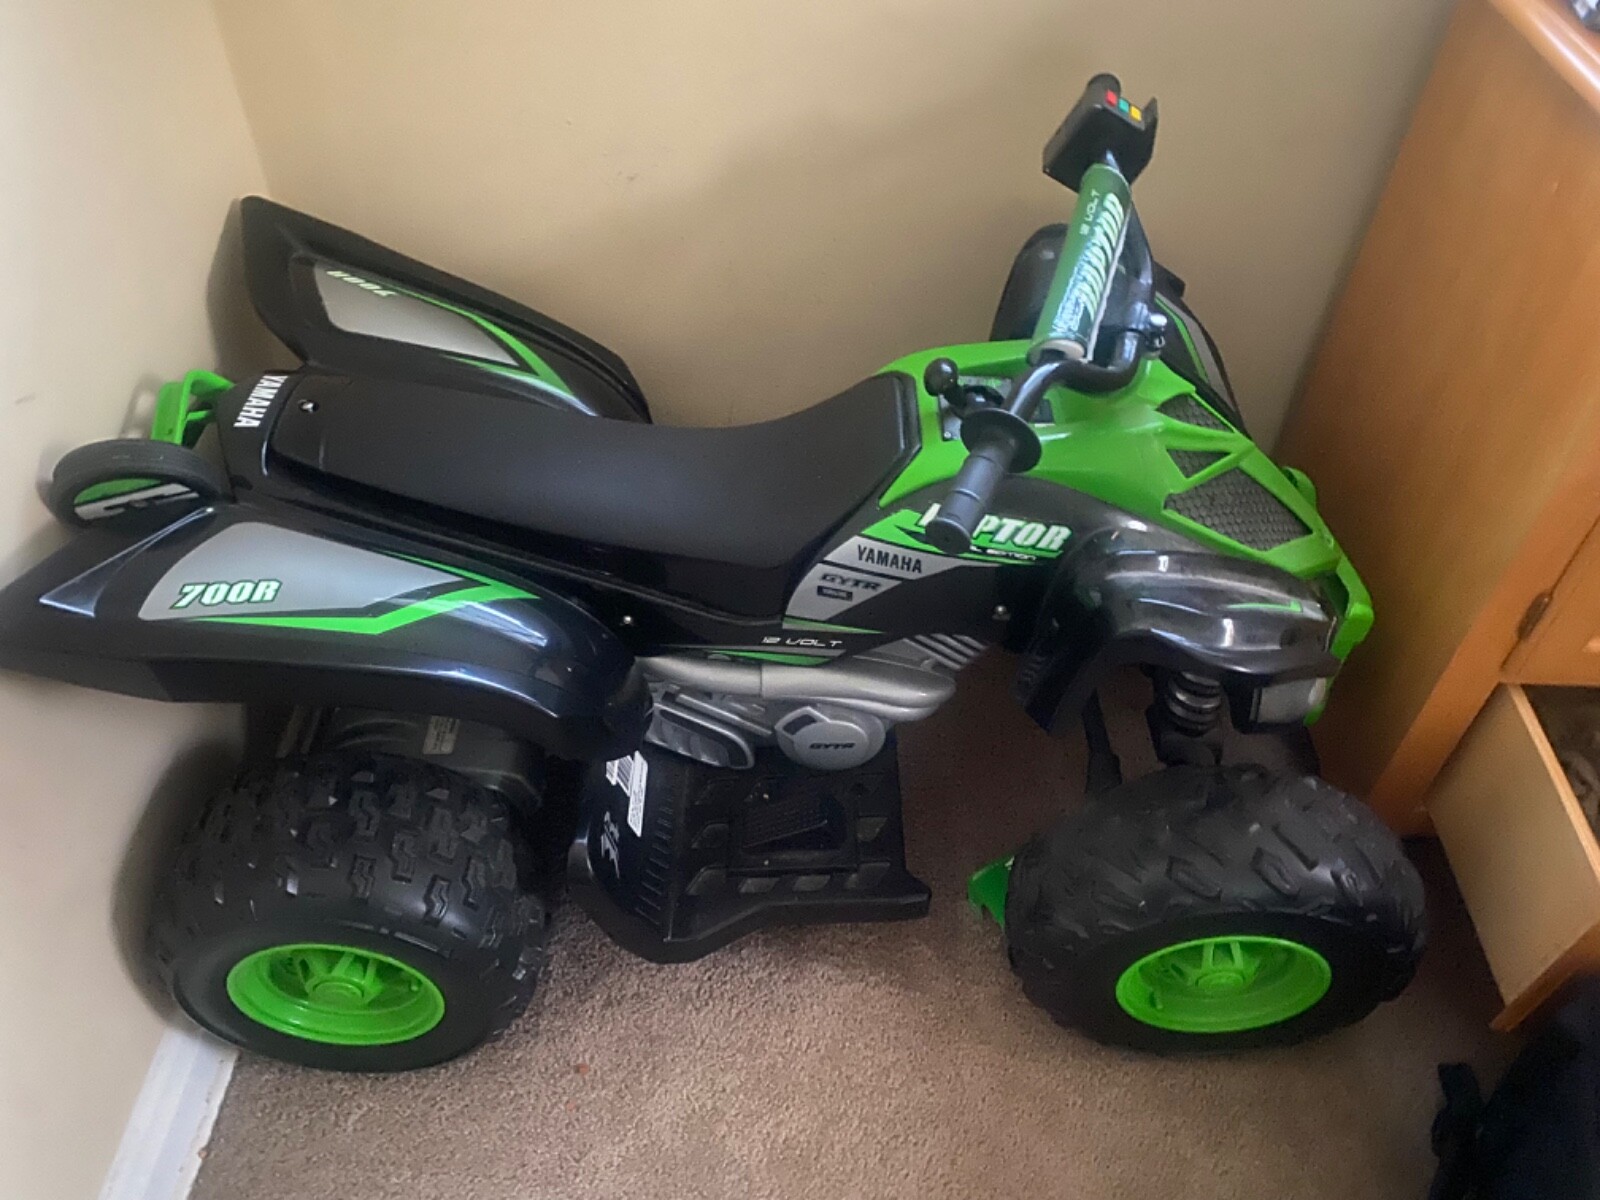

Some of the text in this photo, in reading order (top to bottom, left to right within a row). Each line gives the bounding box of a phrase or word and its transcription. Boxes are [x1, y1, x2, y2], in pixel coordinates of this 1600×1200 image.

[233, 375, 289, 428] YAMAHA
[917, 502, 1073, 551] PTOR
[857, 544, 922, 574] YAMAHA
[172, 579, 282, 609] 700R
[821, 573, 882, 591] GYTR
[785, 637, 843, 647] VOLT
